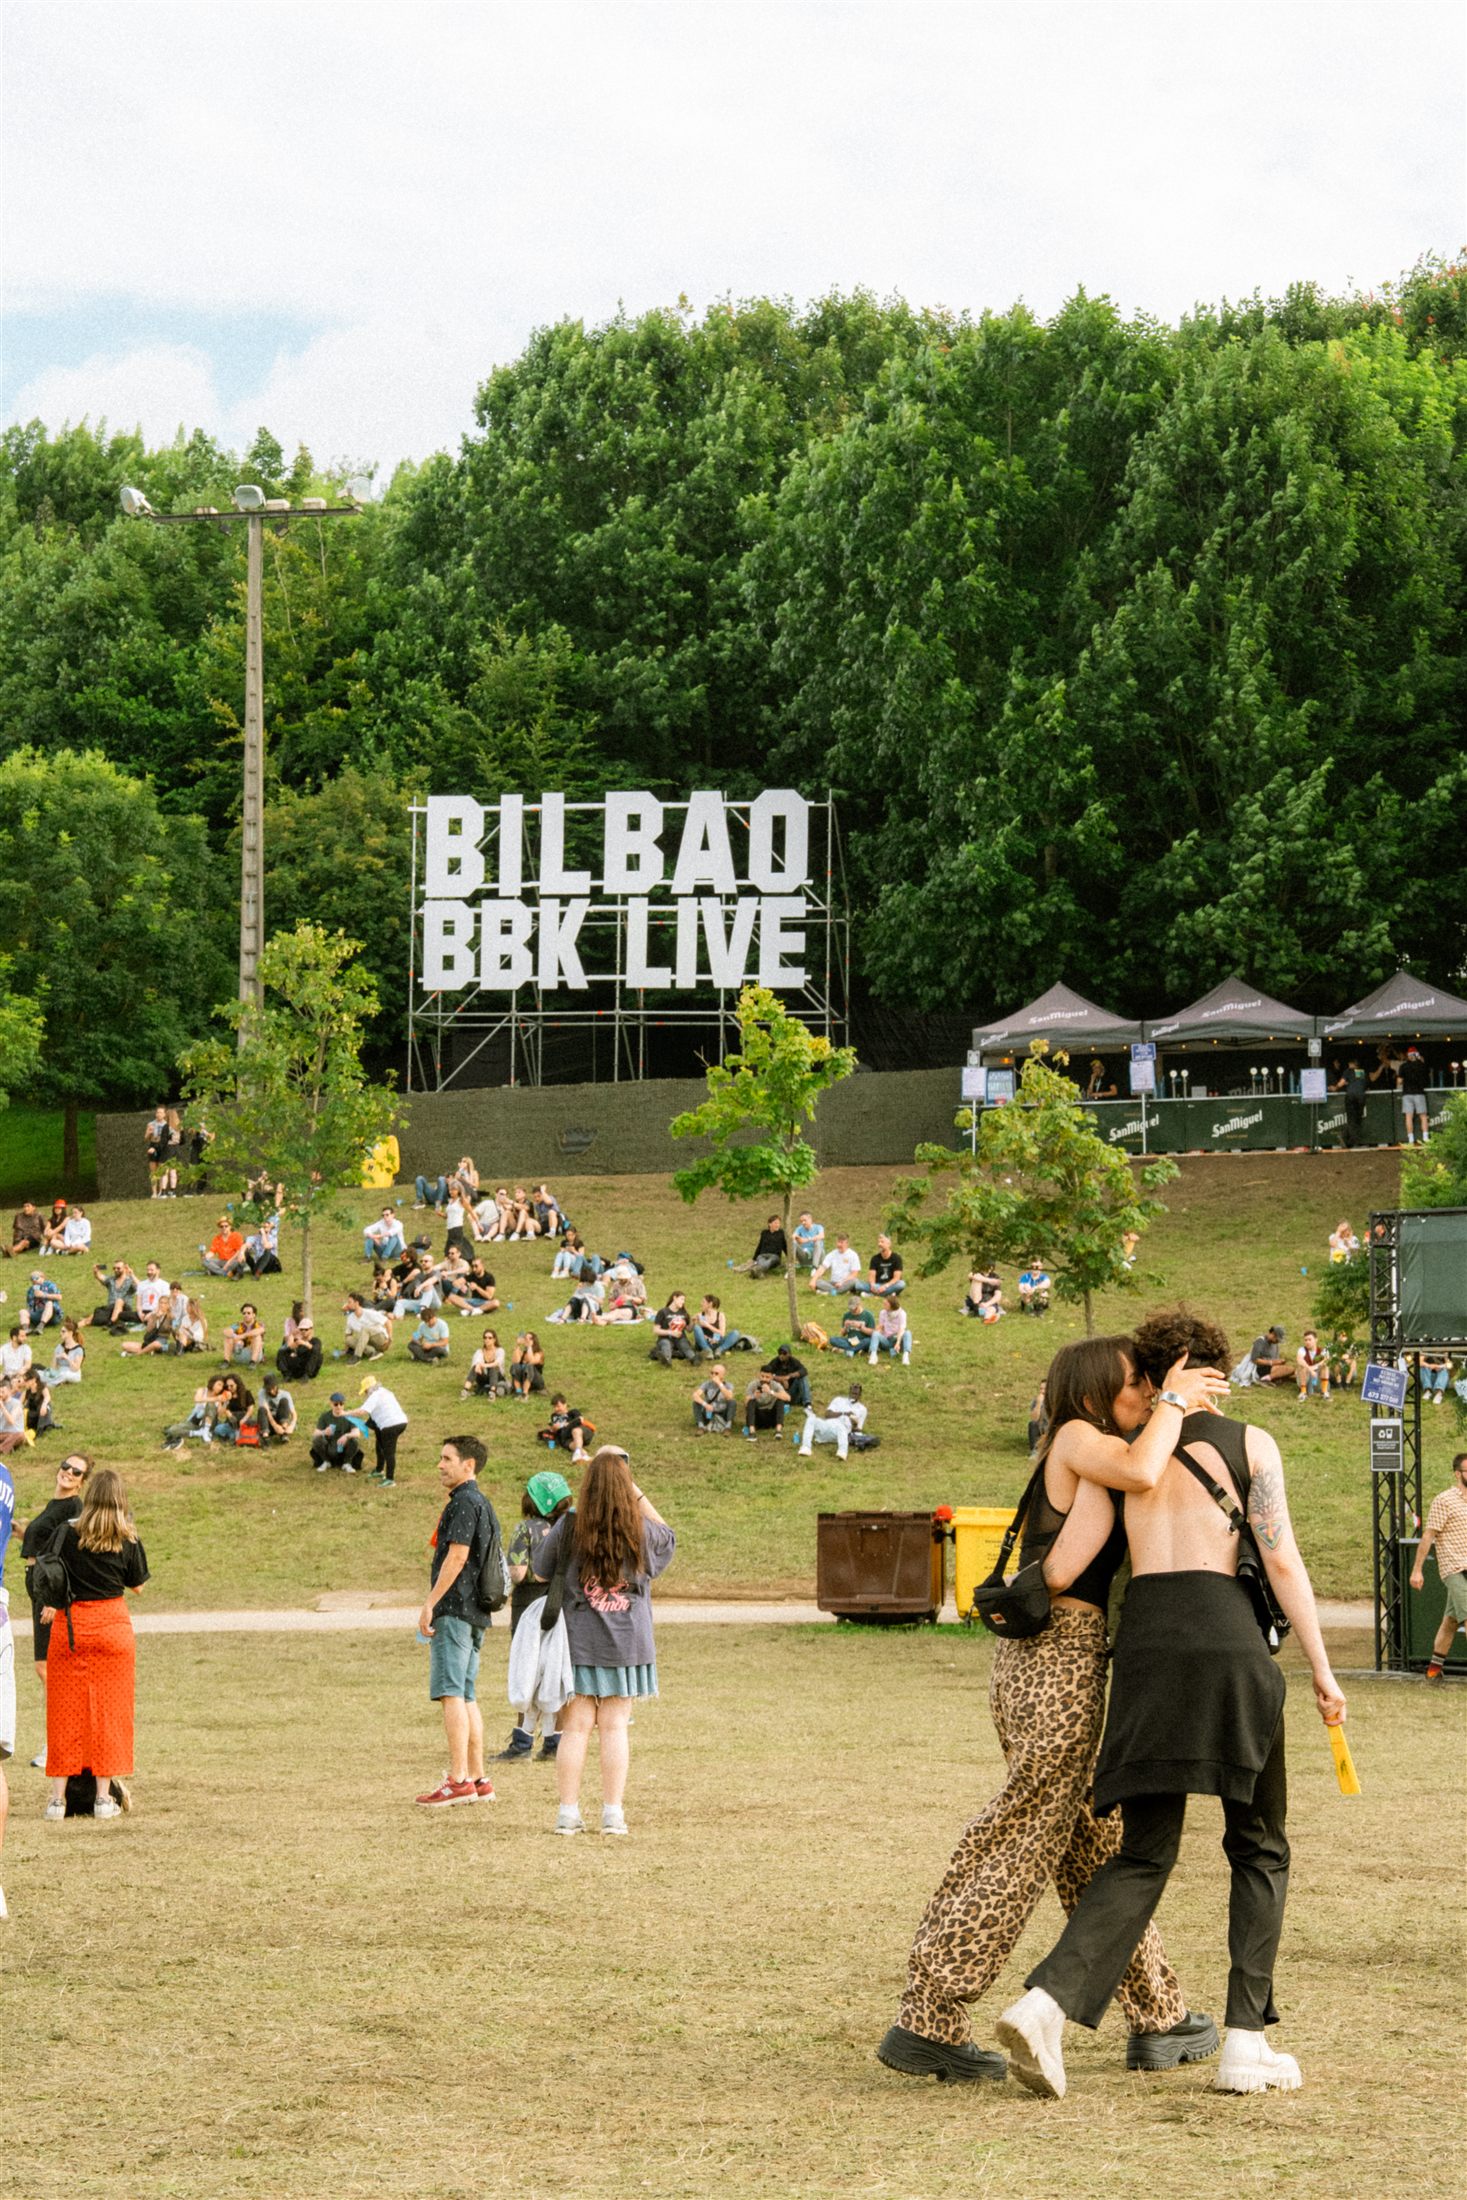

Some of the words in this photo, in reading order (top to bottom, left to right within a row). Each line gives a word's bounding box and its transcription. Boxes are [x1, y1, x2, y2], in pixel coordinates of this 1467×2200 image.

[425, 788, 809, 898] BILBAO
[422, 897, 591, 991] BBK
[625, 896, 807, 990] LIVE
